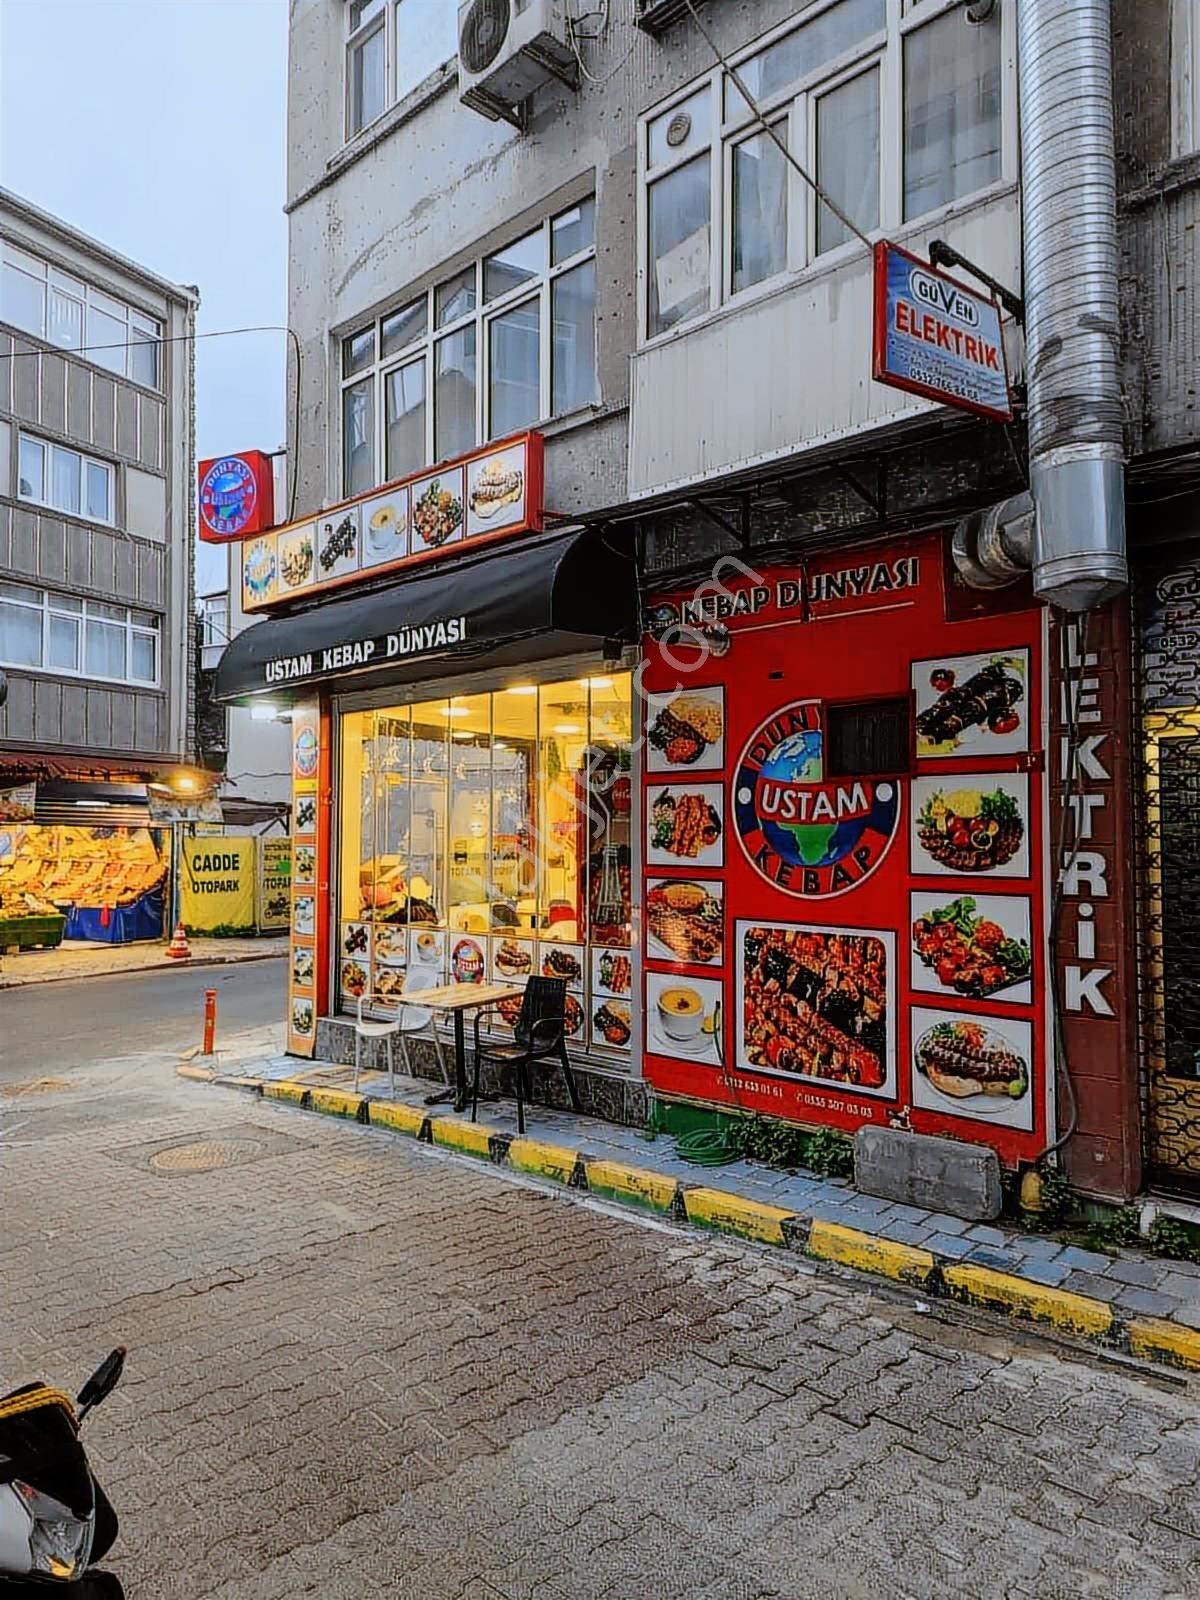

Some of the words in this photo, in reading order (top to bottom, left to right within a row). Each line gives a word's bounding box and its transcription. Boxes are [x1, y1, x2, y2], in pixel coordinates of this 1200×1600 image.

[918, 279, 973, 321] GÜVEN
[895, 301, 999, 372] ELEKTRİK
[681, 586, 770, 624] KEBAP
[265, 654, 313, 682] USTAM
[321, 640, 375, 671] KEBAP
[386, 616, 466, 657] DÜNYASI
[1160, 634, 1196, 649] 0532
[761, 782, 869, 822] USTAM
[192, 853, 240, 873] CADDE
[754, 844, 871, 894] KEBAP
[192, 880, 240, 894] OTOPARK
